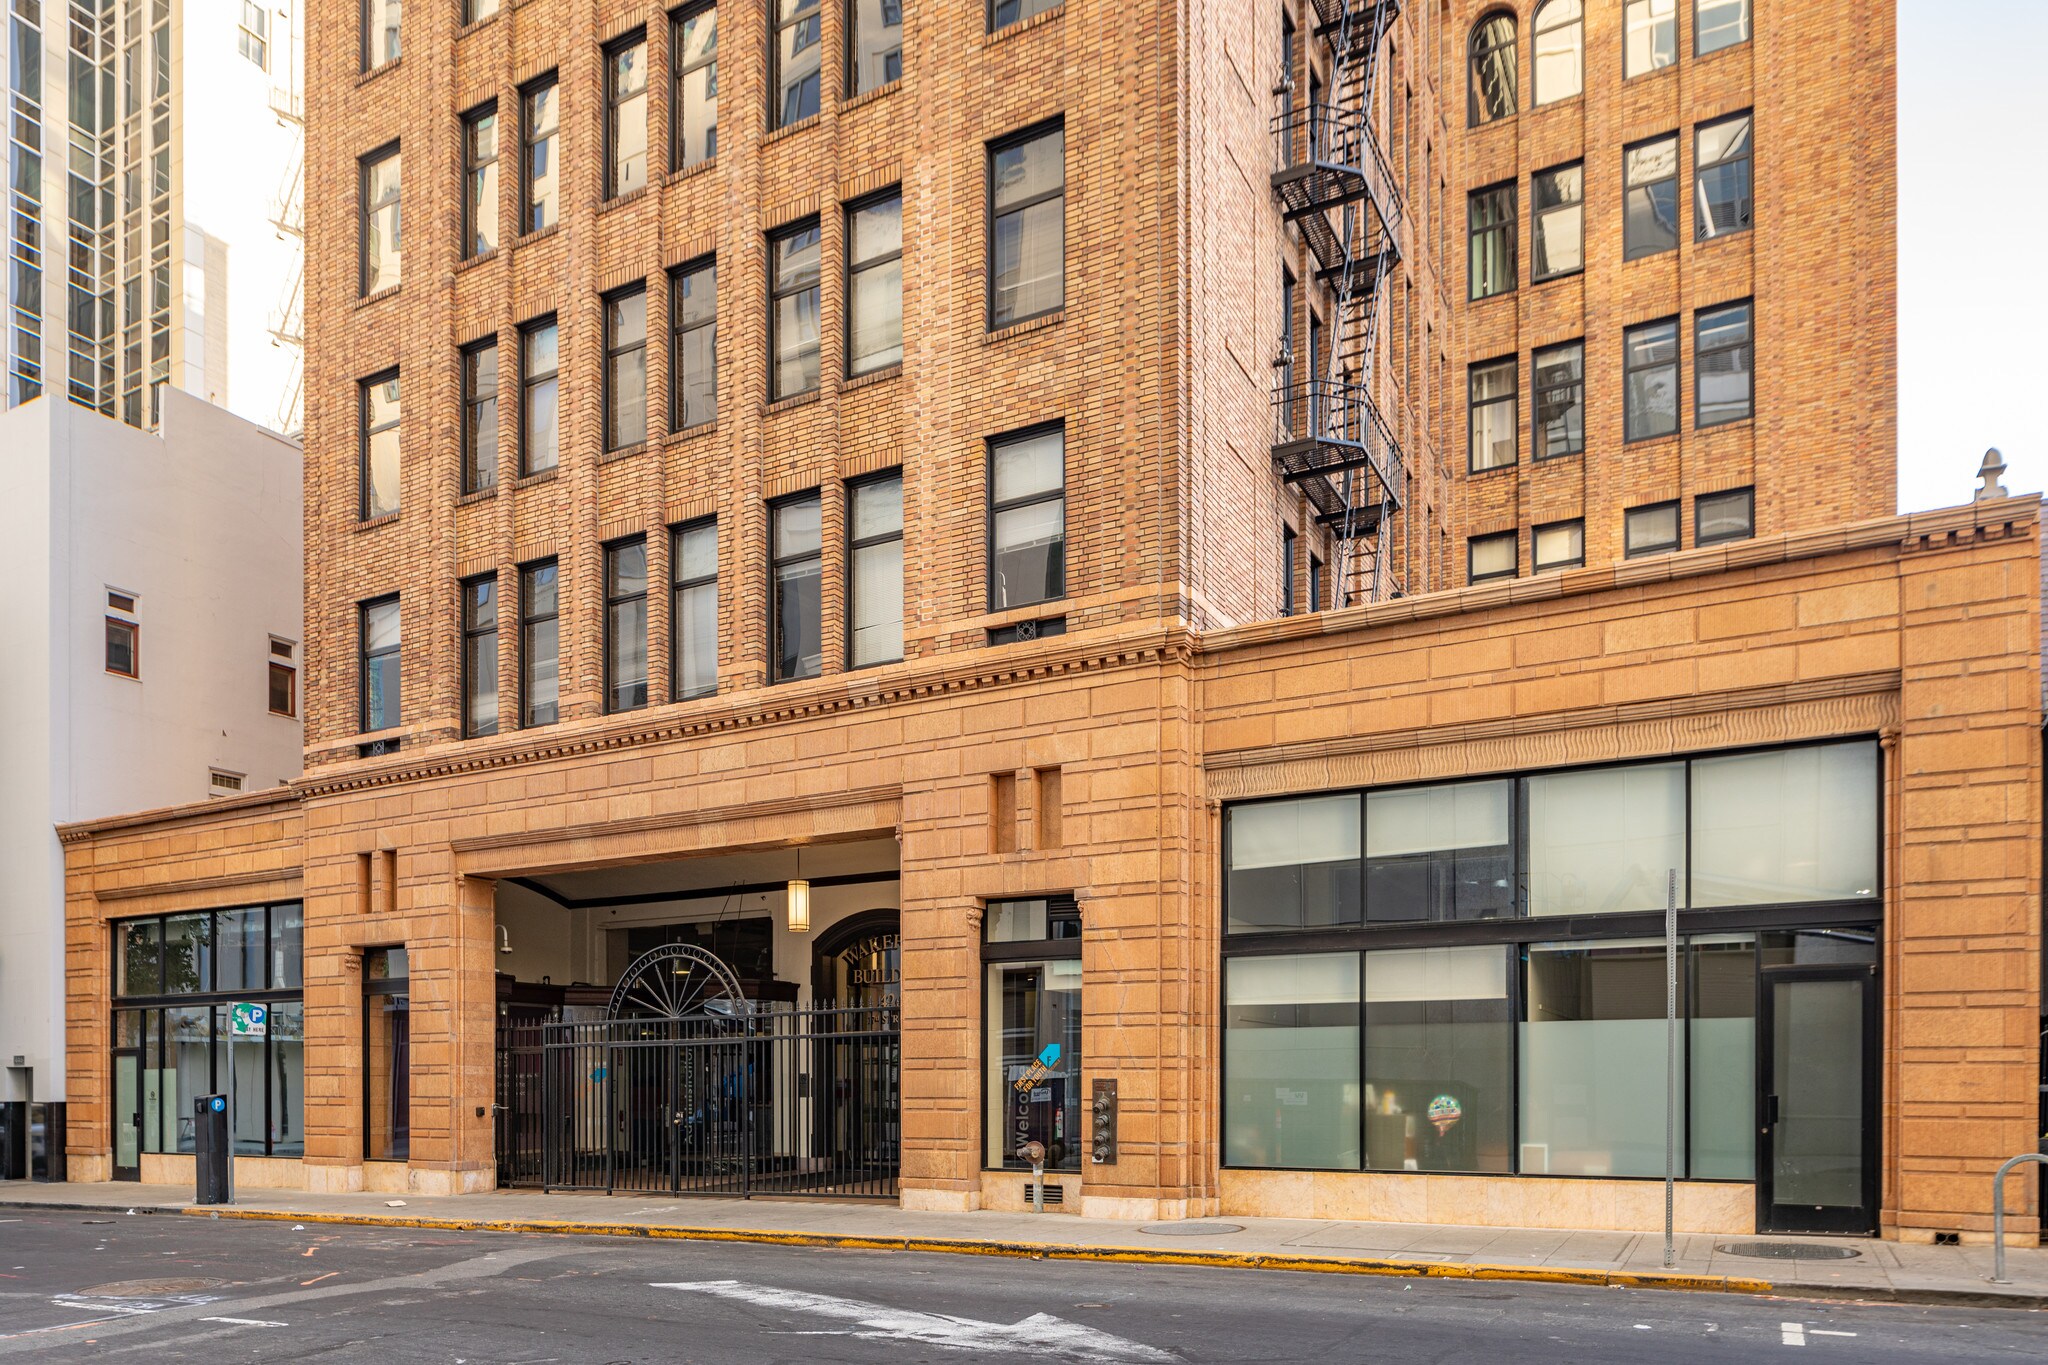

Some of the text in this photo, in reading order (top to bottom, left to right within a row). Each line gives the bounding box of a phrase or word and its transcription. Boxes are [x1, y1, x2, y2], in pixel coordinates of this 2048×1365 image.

[854, 968, 900, 984] BUILD
[1014, 1074, 1028, 1090] FIRST
[1026, 1058, 1042, 1076] PLACE
[1023, 1080, 1035, 1093] FOR
[1032, 1064, 1048, 1083] YOUTH
